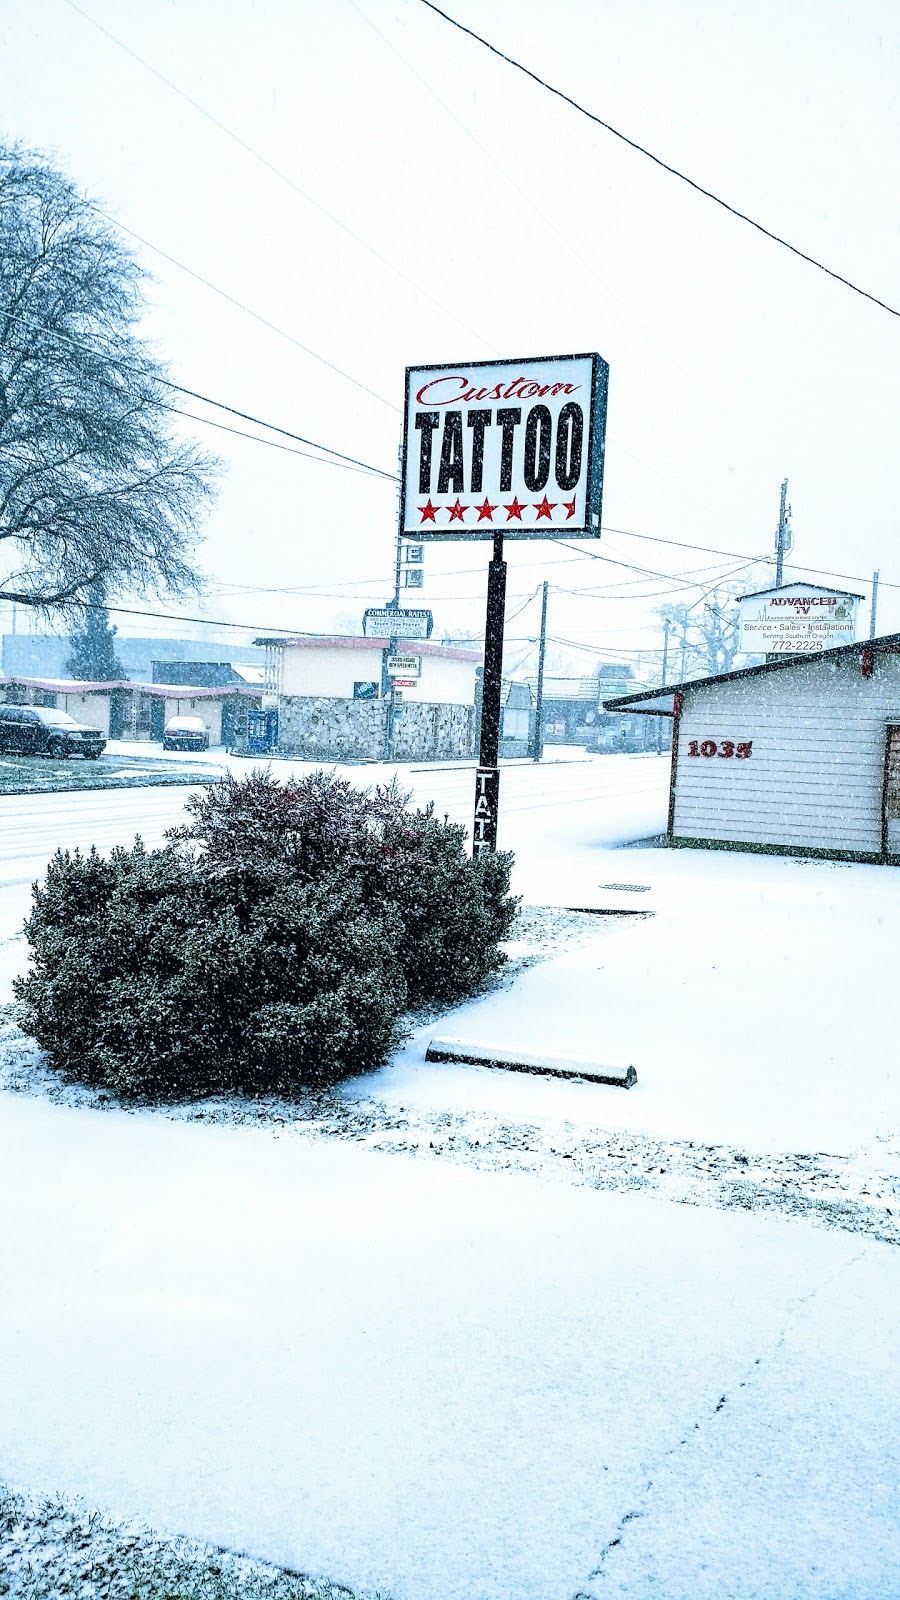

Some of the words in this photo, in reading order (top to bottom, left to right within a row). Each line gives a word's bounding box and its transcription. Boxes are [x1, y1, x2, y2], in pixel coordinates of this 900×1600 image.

[416, 376, 582, 405] Custom
[415, 402, 583, 494] TATTOO
[770, 597, 837, 606] ADVANCED
[368, 609, 406, 617] COMMERCIAL
[794, 606, 810, 615] TV
[744, 623, 772, 631] Service
[779, 623, 800, 631] Sales
[808, 623, 854, 631] Installations
[772, 641, 823, 650] 772-2225
